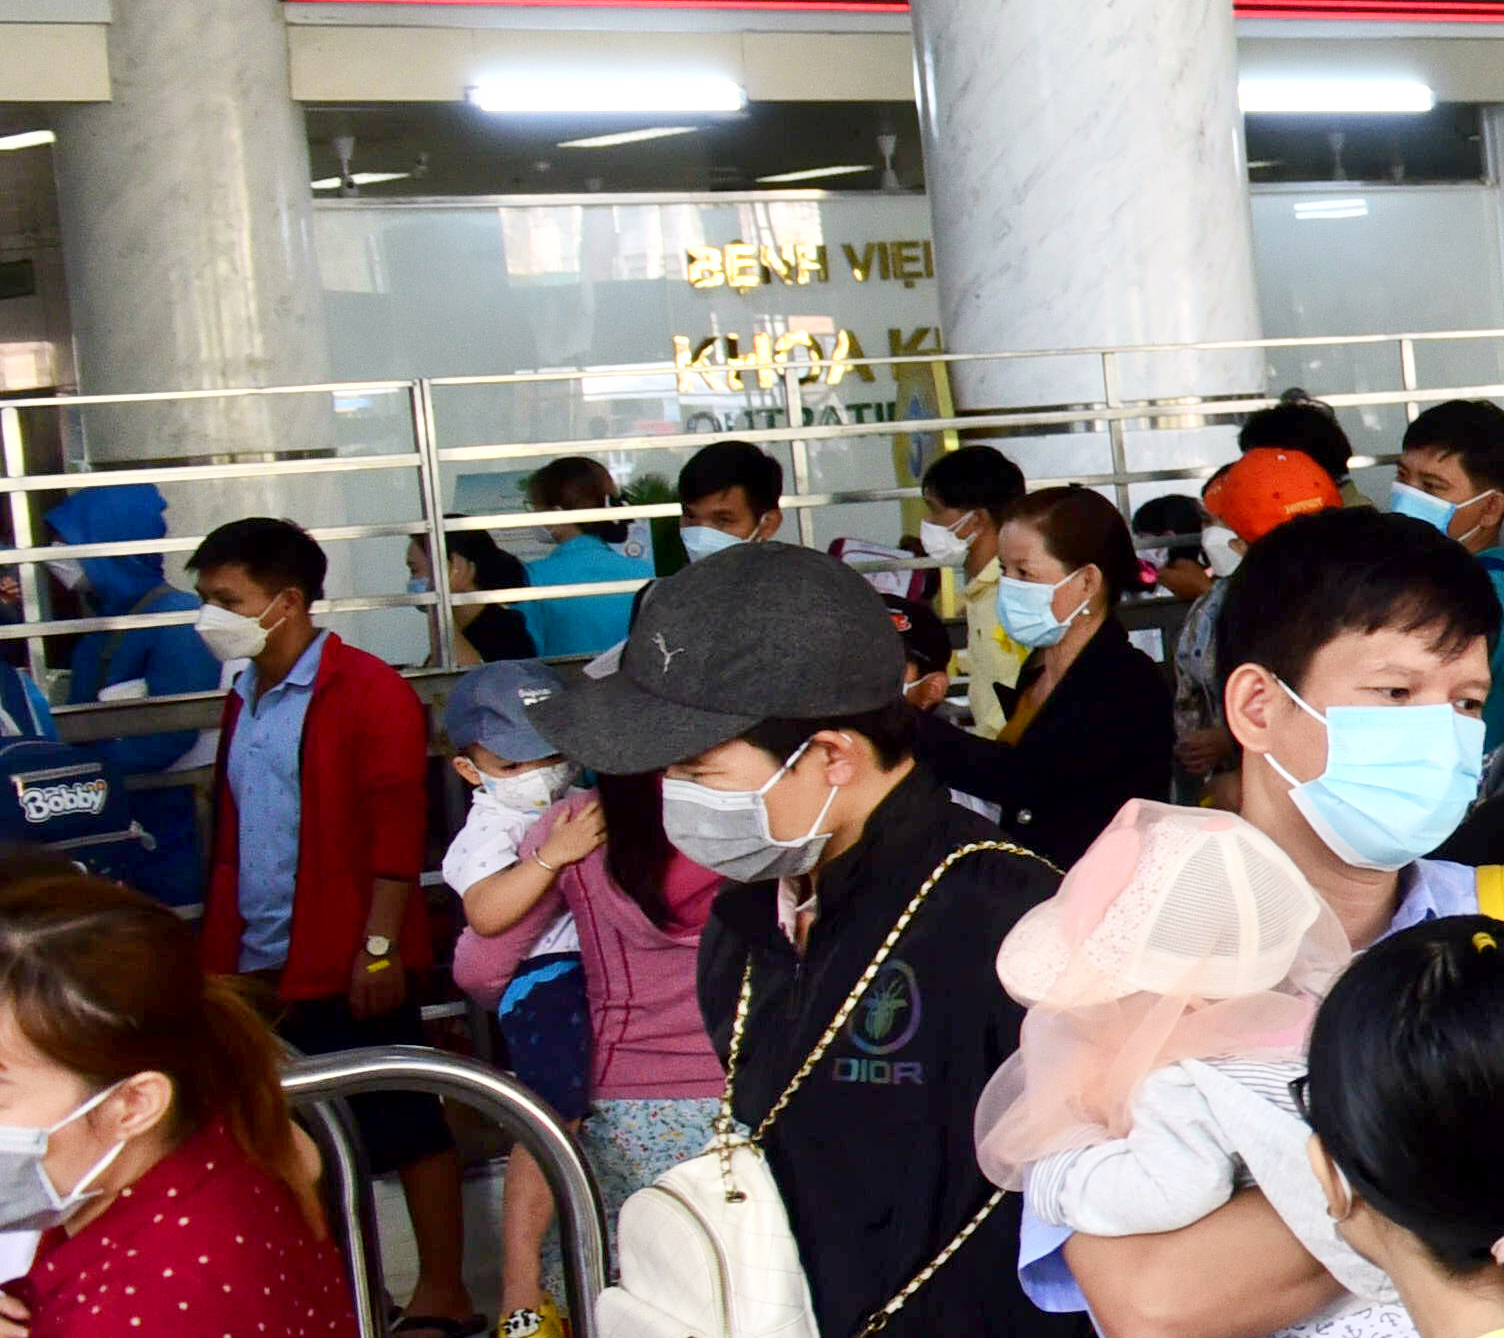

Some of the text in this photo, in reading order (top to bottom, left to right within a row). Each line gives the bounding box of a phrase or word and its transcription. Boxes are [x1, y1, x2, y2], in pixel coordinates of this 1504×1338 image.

[687, 239, 829, 294] BỆNH
[673, 328, 875, 393] KHOA
[20, 780, 106, 822] Bobby
[832, 1058, 924, 1086] DIOR
